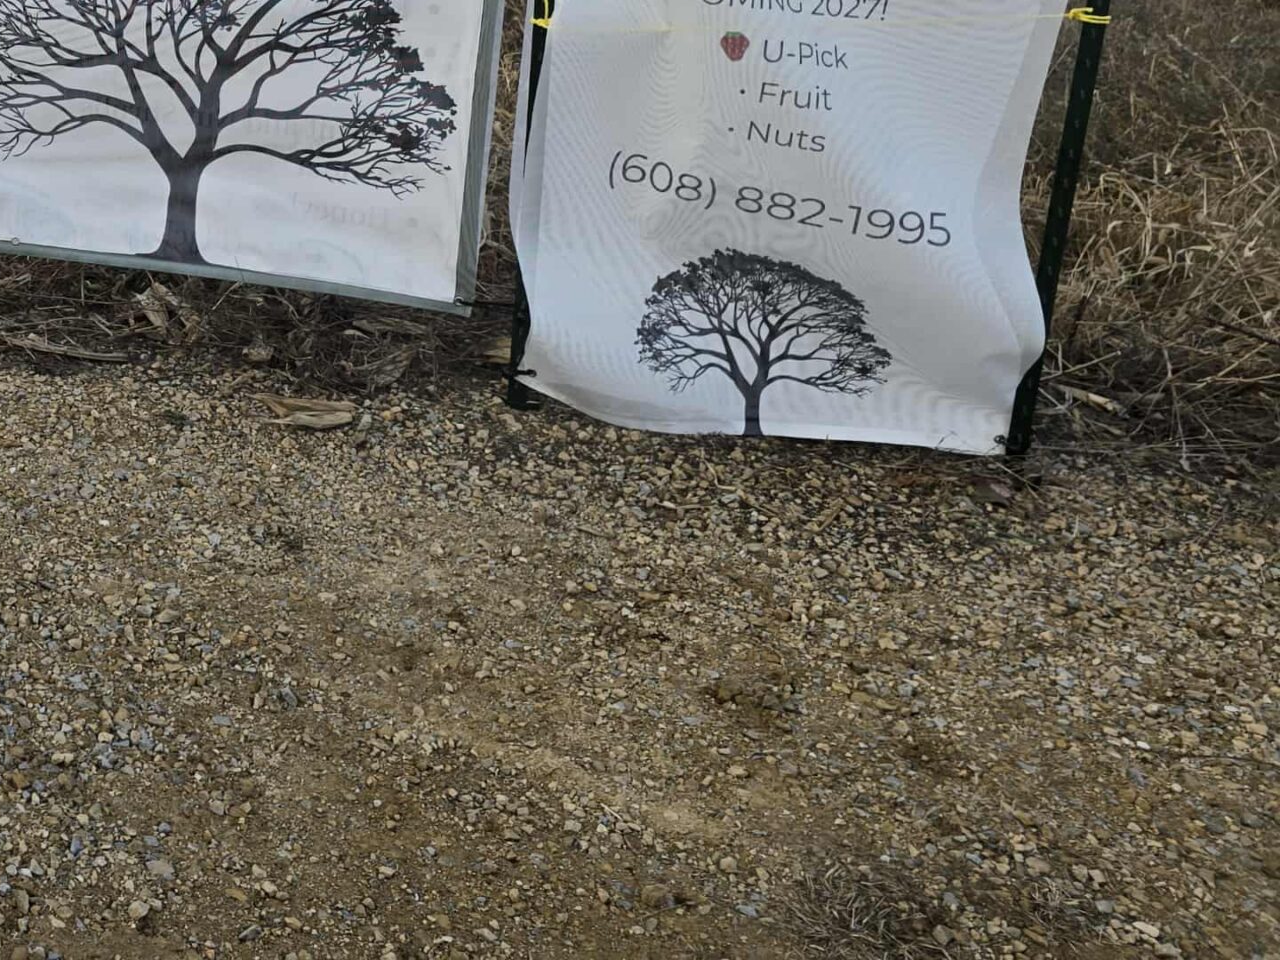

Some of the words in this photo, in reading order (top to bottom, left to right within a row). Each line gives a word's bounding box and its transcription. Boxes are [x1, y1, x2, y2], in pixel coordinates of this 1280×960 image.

[762, 38, 849, 71] U-Pick
[758, 81, 833, 112] Fruit
[747, 120, 826, 153] Nuts
[608, 151, 718, 210] (608)
[734, 186, 952, 247] 882-1995
